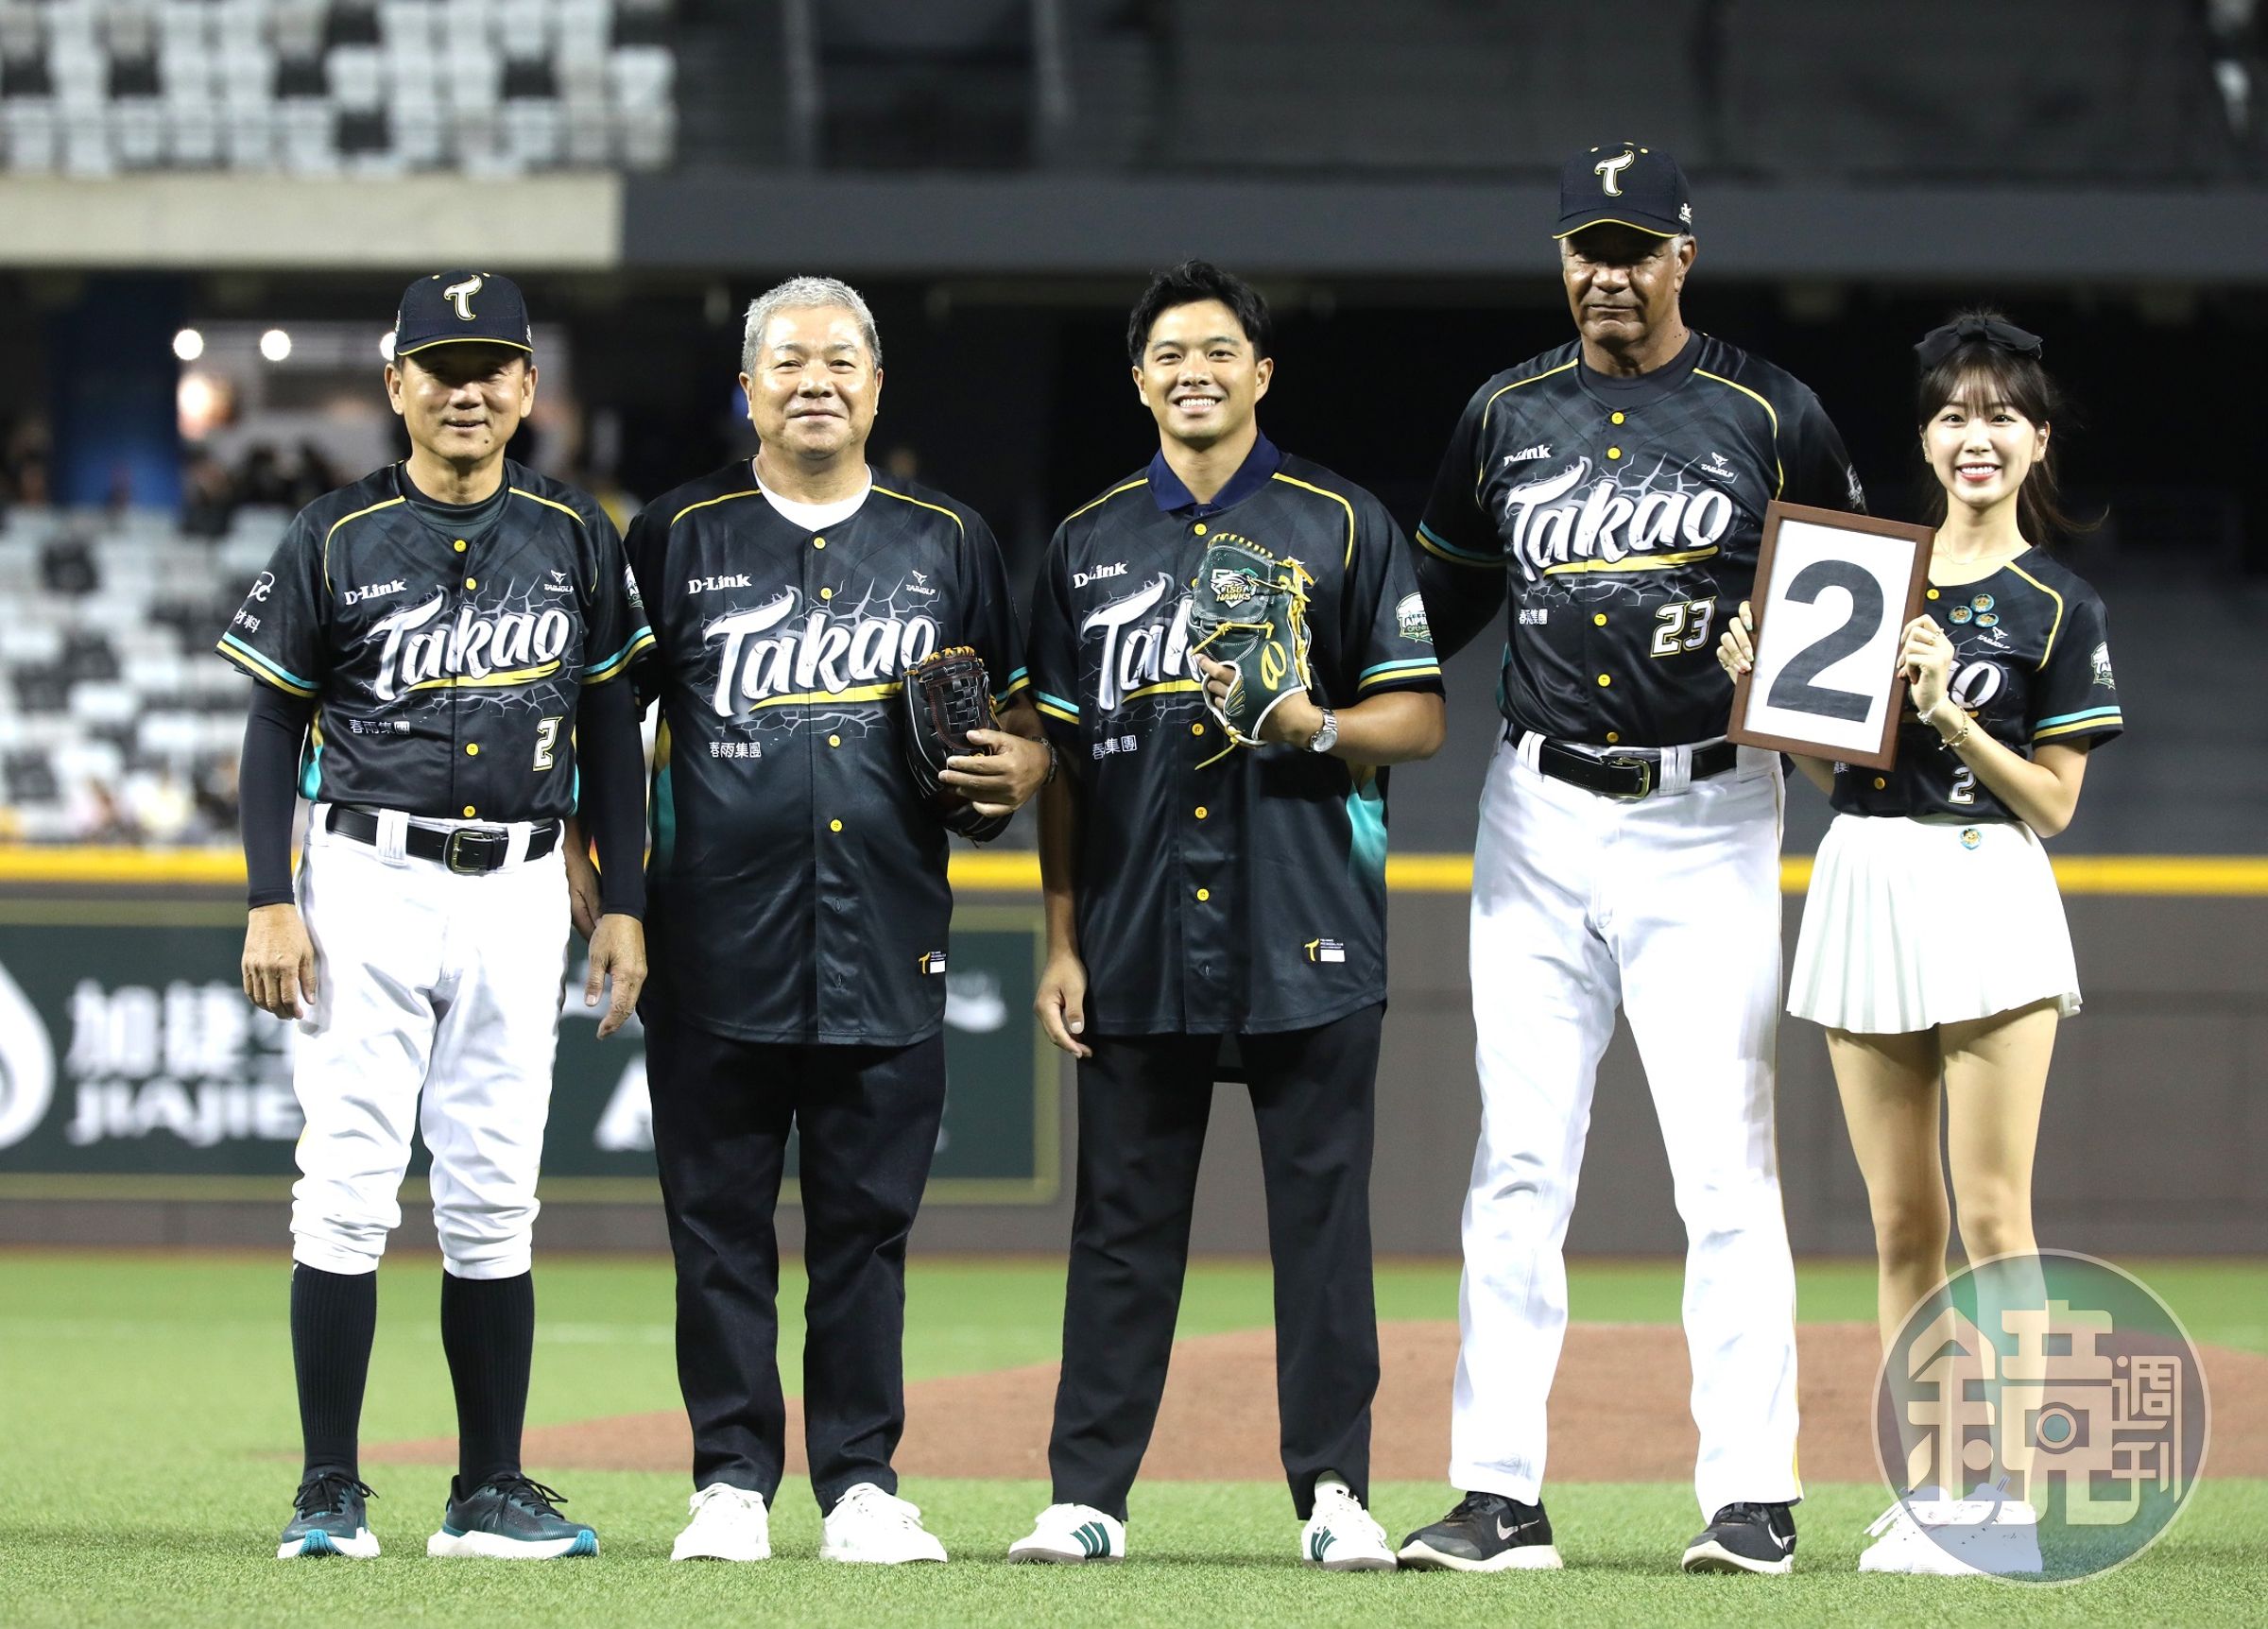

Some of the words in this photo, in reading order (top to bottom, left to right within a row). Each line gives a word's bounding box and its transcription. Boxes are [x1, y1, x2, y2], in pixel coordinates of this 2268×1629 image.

[1506, 458, 1733, 583] Takao
[343, 579, 407, 606] D-Link
[687, 573, 752, 594] D-Link
[1215, 592, 1251, 602] HAWKS
[367, 588, 569, 701] Takao
[704, 588, 936, 718] Takao
[1082, 574, 1202, 711] Tak
[1650, 596, 1717, 659] 23
[1765, 558, 1884, 724] 2
[533, 716, 563, 772] 2
[1092, 734, 1138, 760] 春集團
[1949, 765, 1976, 805] 2
